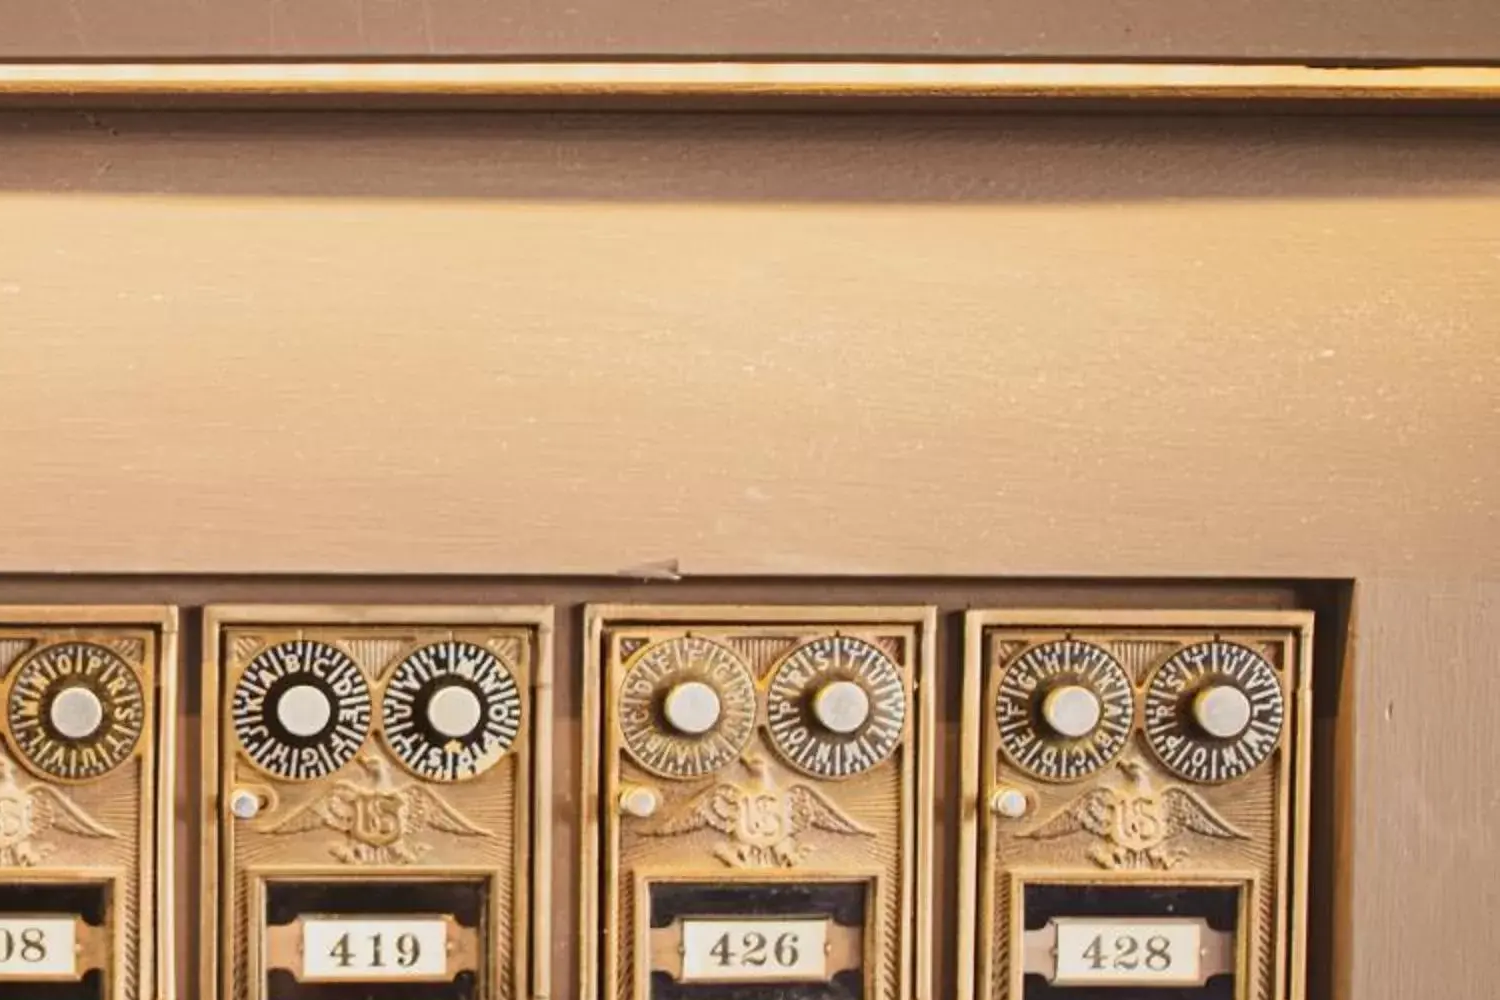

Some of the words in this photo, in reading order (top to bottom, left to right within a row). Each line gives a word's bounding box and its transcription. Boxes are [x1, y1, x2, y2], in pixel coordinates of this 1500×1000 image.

[56, 656, 72, 675] O
[85, 657, 103, 676] P
[283, 654, 300, 673] B
[312, 656, 332, 678] C
[427, 658, 446, 677] L
[455, 656, 477, 679] M
[814, 652, 831, 672] S
[844, 651, 858, 671] T
[1043, 655, 1061, 675] H
[1073, 658, 1089, 676] J
[1191, 656, 1207, 676] T
[1221, 656, 1238, 676] U
[329, 933, 421, 968] 419
[709, 932, 799, 967] 426
[1082, 935, 1172, 969] 428
